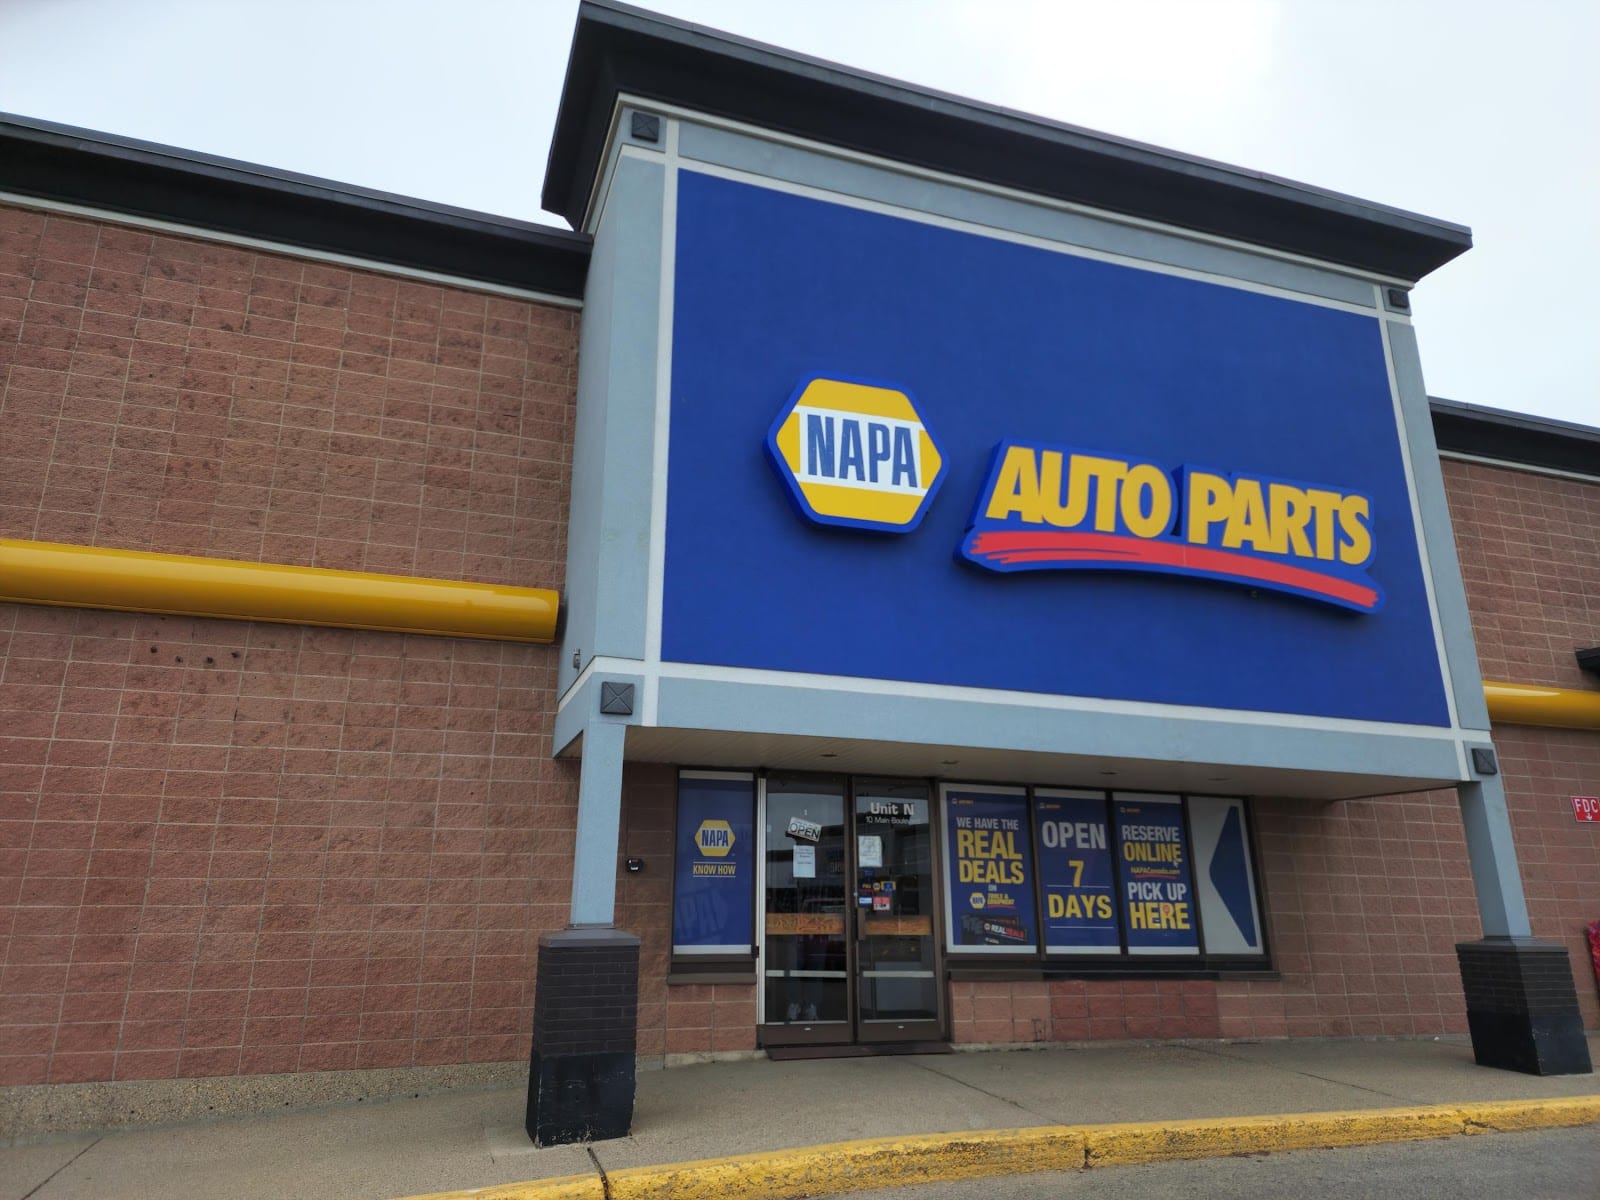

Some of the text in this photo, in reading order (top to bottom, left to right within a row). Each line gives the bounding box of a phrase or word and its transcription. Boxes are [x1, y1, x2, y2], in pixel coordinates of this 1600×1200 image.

[806, 413, 919, 488] NAPA
[985, 445, 1372, 566] AUTO PARTS
[870, 802, 914, 815] Unit N
[1574, 798, 1599, 813] FDC
[874, 815, 889, 824] Main
[956, 816, 1019, 831] WE HAVE THE
[701, 829, 729, 847] NAPA
[789, 822, 820, 839] OPEN
[1041, 820, 1106, 850] OPEN
[1121, 825, 1180, 842] RESERVE
[957, 829, 1023, 860] REAL
[1123, 842, 1183, 862] ONLINE
[692, 864, 736, 875] KNOW HOW
[959, 860, 1025, 885] DEALS
[1068, 860, 1085, 887] 7
[1127, 881, 1187, 901] PICK UP
[1048, 894, 1112, 919] DAYS
[1129, 902, 1191, 930] HERE
